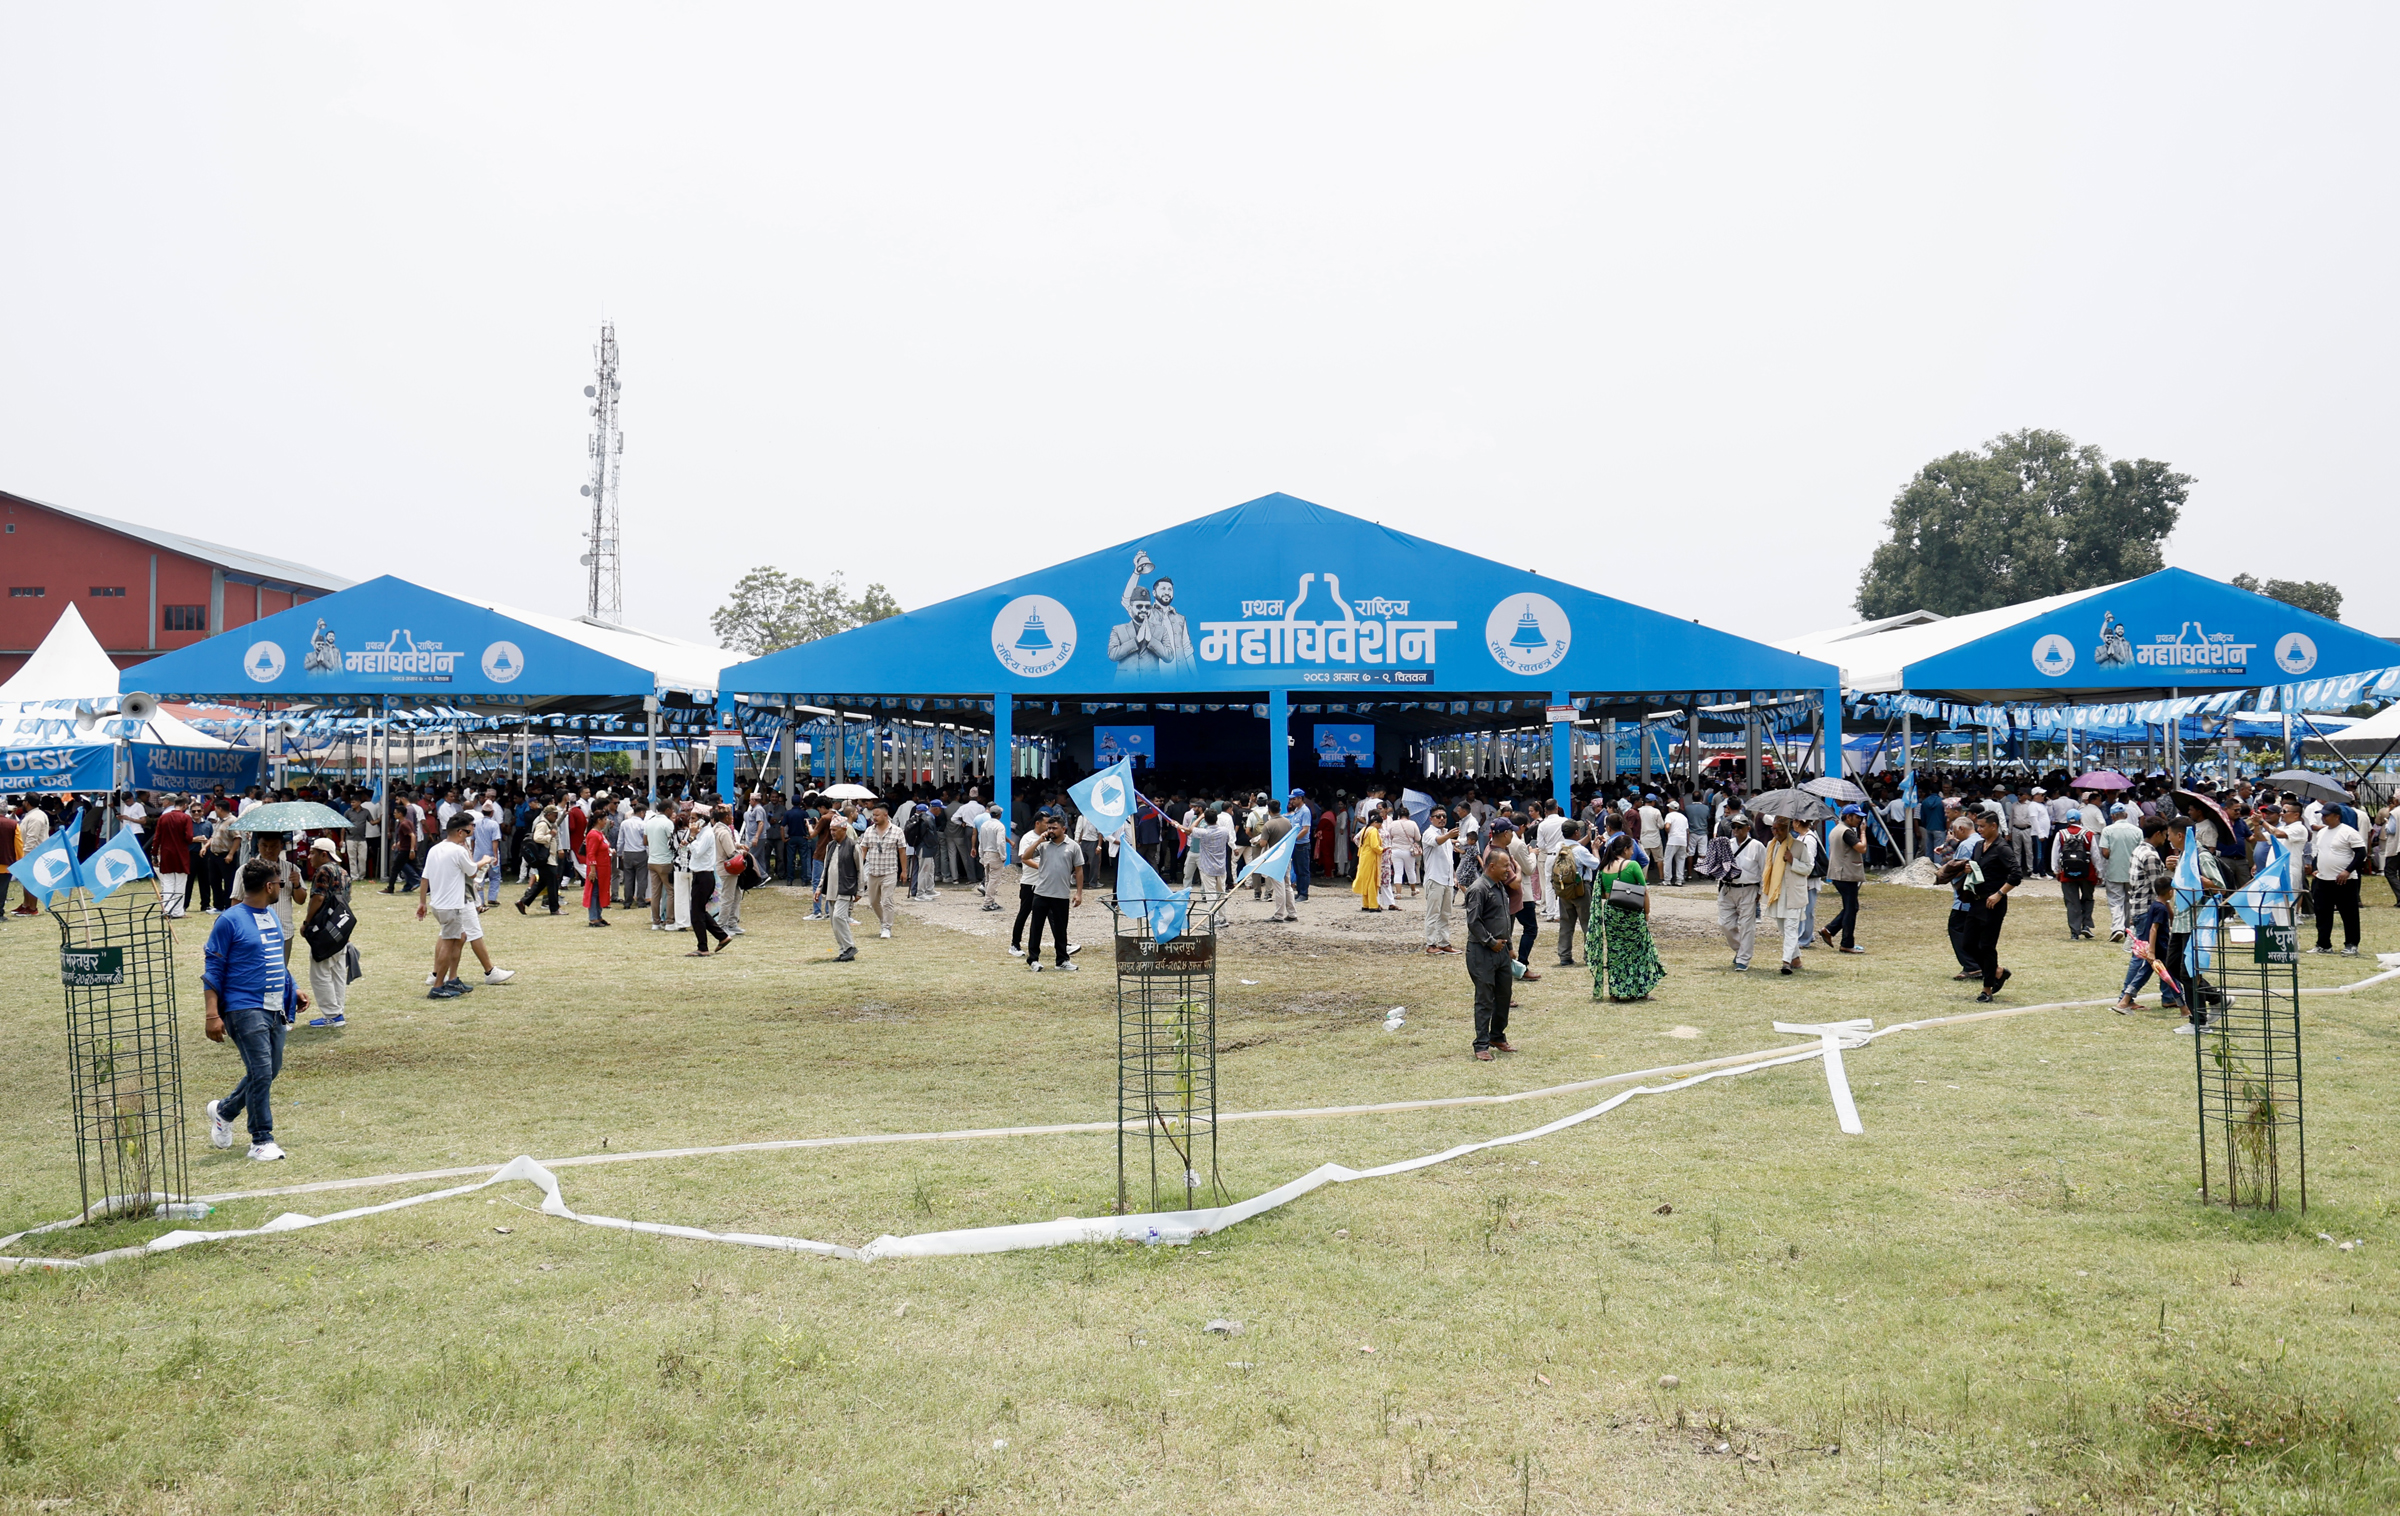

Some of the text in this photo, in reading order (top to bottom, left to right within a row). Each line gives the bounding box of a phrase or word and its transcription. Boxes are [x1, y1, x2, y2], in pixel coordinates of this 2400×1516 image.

[1200, 573, 1457, 664] महाधिवेशन
[1241, 596, 1410, 620] प्रथम राष्ट्रिय
[365, 641, 385, 650] प्रथम
[2136, 621, 2257, 665] महाधिवेशन
[2155, 634, 2176, 643] प्रथम
[345, 629, 465, 673] महाधिवेशन
[996, 641, 1071, 674] राष्ट्रिय स्वतन्त्र पार्टी
[1490, 639, 1566, 672] राष्ट्रिय स्वतन्त्र पार्टी
[1303, 673, 1330, 682] २०८३
[1333, 672, 1359, 682] असार
[1362, 673, 1371, 682] ७
[1394, 671, 1427, 682] चितवन
[5, 748, 78, 771] DESK
[147, 748, 245, 773] HEALTH DESK
[39, 773, 73, 788] कक्ष
